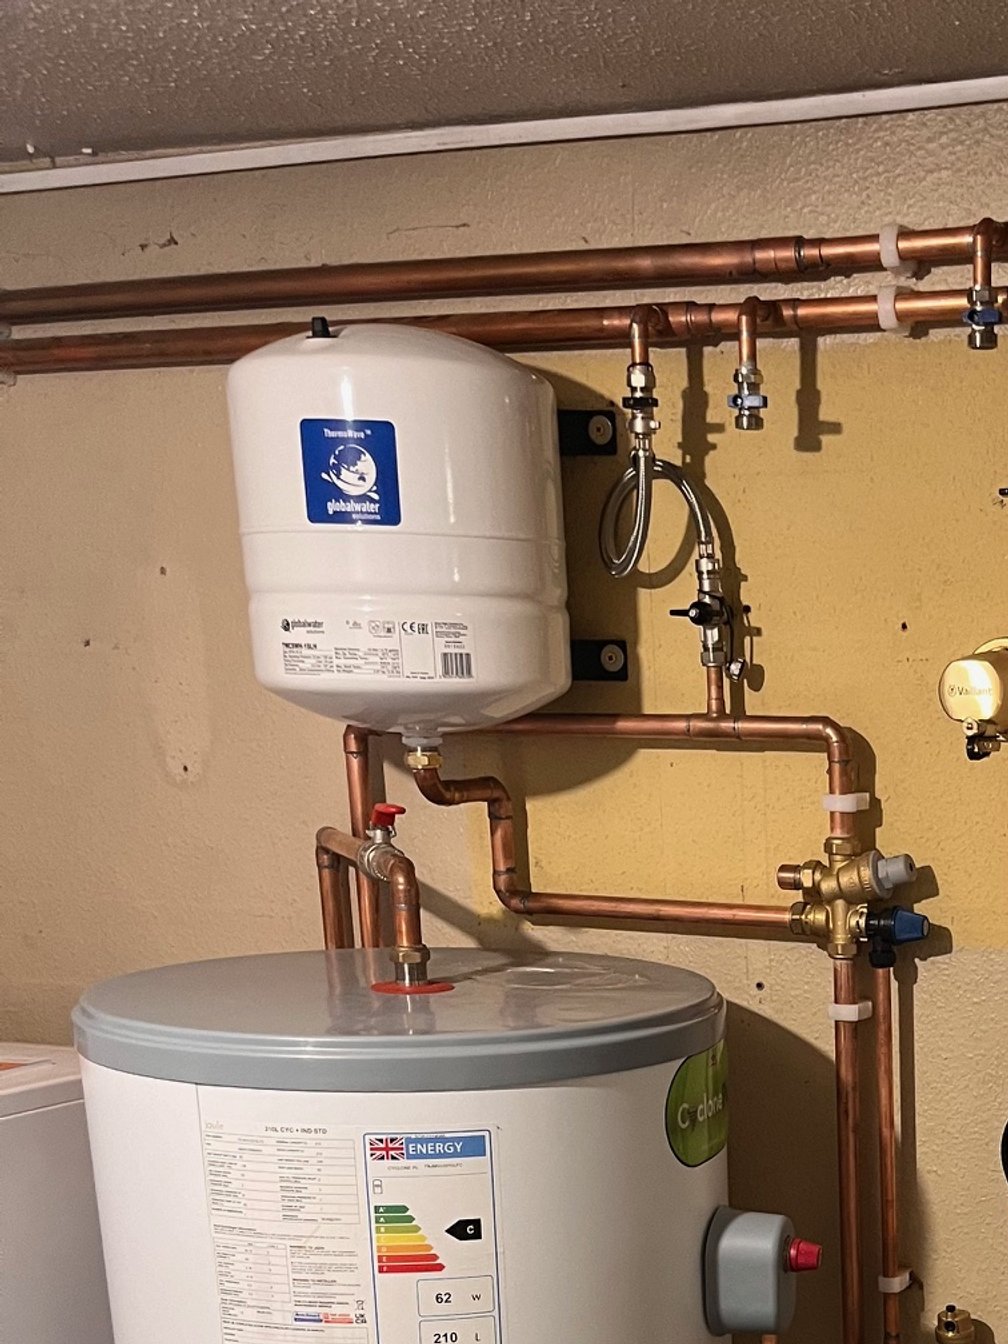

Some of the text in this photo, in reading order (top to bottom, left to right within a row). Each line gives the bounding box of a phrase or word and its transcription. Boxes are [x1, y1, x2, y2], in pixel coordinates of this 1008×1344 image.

[327, 499, 380, 515] globalwater
[409, 1142, 463, 1155] ENERGY
[467, 1225, 475, 1234] C
[435, 1292, 452, 1304] 62
[434, 1332, 458, 1343] 210
